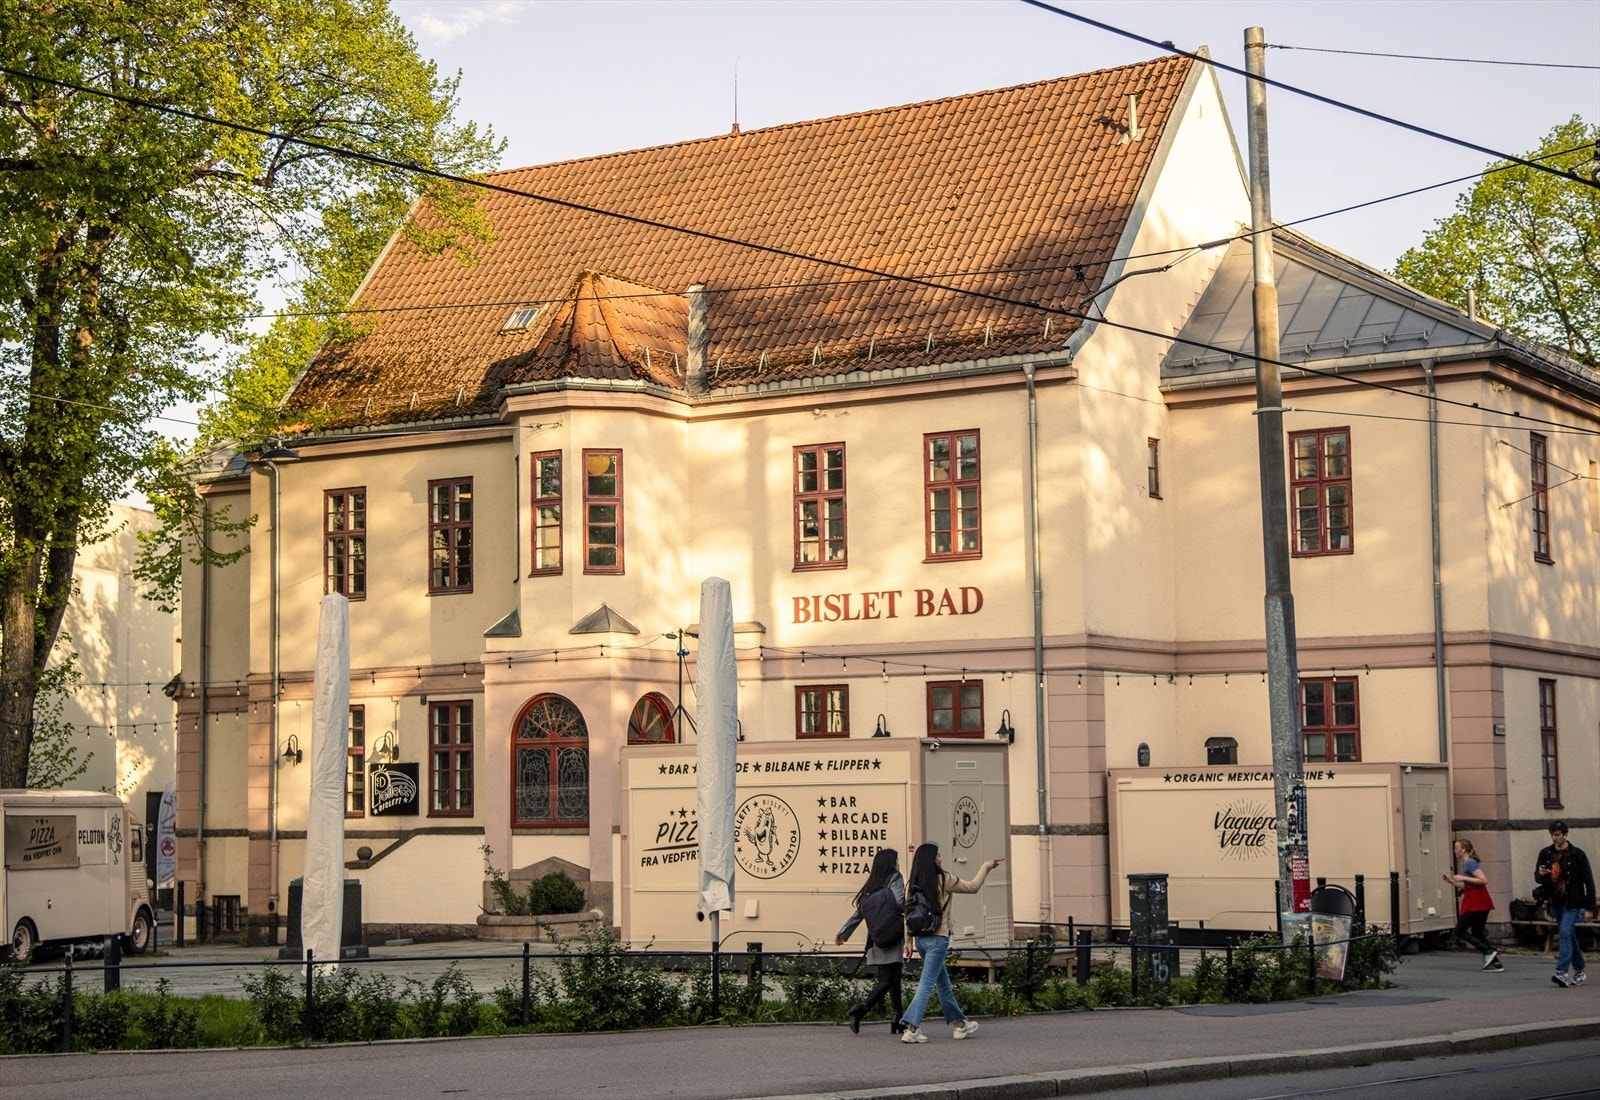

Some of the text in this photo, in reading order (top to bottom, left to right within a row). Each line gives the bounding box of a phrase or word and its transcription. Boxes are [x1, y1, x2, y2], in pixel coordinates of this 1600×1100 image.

[792, 586, 984, 624] BISLET BAD
[668, 759, 870, 775] BAR BILBANE FLIPPER
[1174, 773, 1224, 784] ORGANIC
[762, 799, 789, 817] BISLETT
[830, 796, 857, 808] BAR
[734, 804, 751, 843] POLLETT
[831, 812, 889, 825] ARCADE
[29, 826, 55, 844] PIZZA
[78, 830, 105, 844] PELOTON
[655, 820, 699, 844] PIZZ
[831, 829, 887, 842] BILBANE
[1220, 829, 1266, 849] Verde
[781, 829, 798, 869] POLLETT
[23, 853, 32, 862] FRA
[641, 856, 659, 867] FRA
[741, 857, 768, 875] BISLETT
[831, 862, 871, 874] PIZZA
